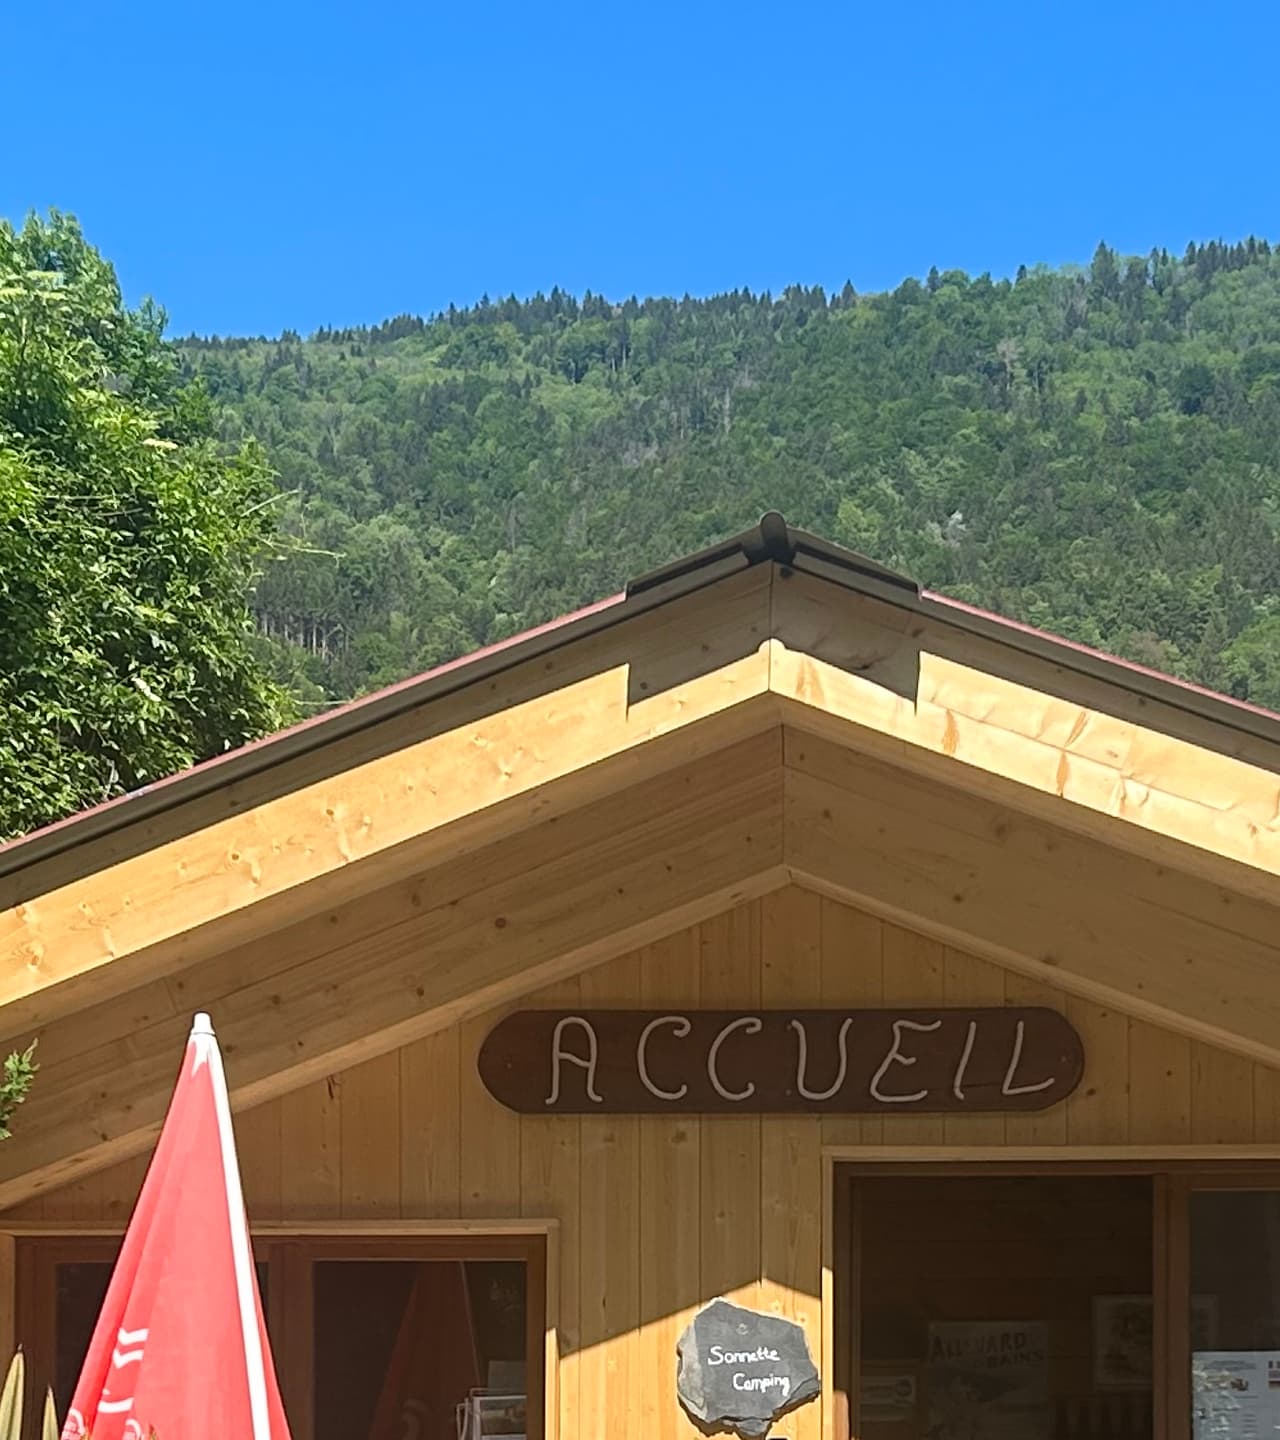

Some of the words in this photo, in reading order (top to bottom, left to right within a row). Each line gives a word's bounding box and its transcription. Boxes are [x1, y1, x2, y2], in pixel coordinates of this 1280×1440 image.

[545, 1016, 1056, 1104] ACCUEIL
[708, 1346, 780, 1365] Sonnette
[732, 1373, 791, 1397] Camping
